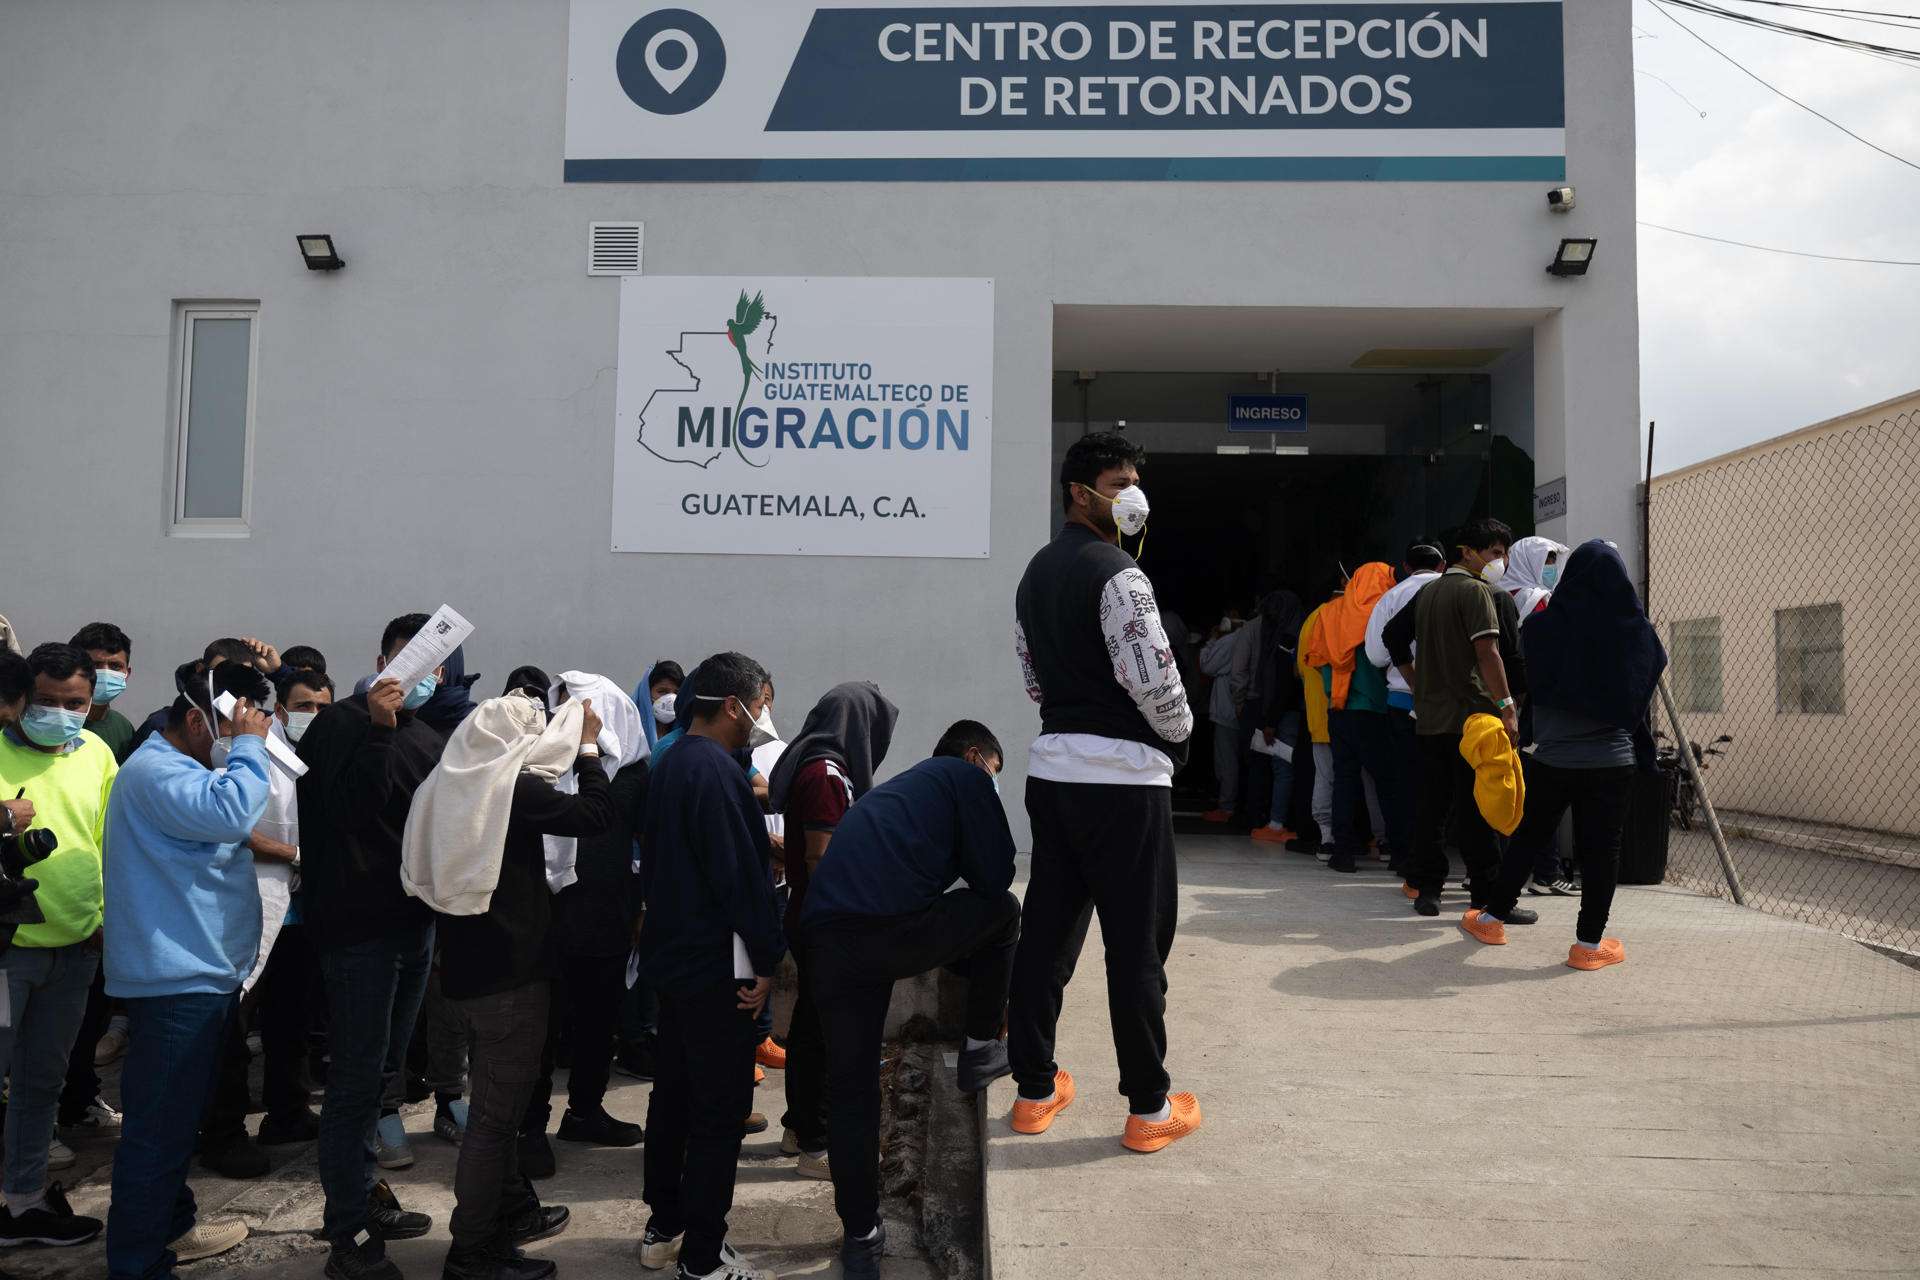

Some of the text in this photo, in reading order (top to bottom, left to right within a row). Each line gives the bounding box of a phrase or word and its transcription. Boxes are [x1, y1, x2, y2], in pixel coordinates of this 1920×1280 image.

[878, 11, 1488, 62] CENTRO DE RECEPCIÓN
[960, 74, 1413, 116] DE RETORNADOS
[764, 362, 872, 381] INSTITUTO
[764, 383, 969, 403] GUATEMALTECO DE
[677, 402, 970, 451] MIGRACIÓN
[1235, 407, 1302, 420] INGRESO
[681, 493, 926, 520] GUATEMALA, C.A.
[1129, 590, 1145, 618] DAN
[1137, 591, 1151, 614] JOR
